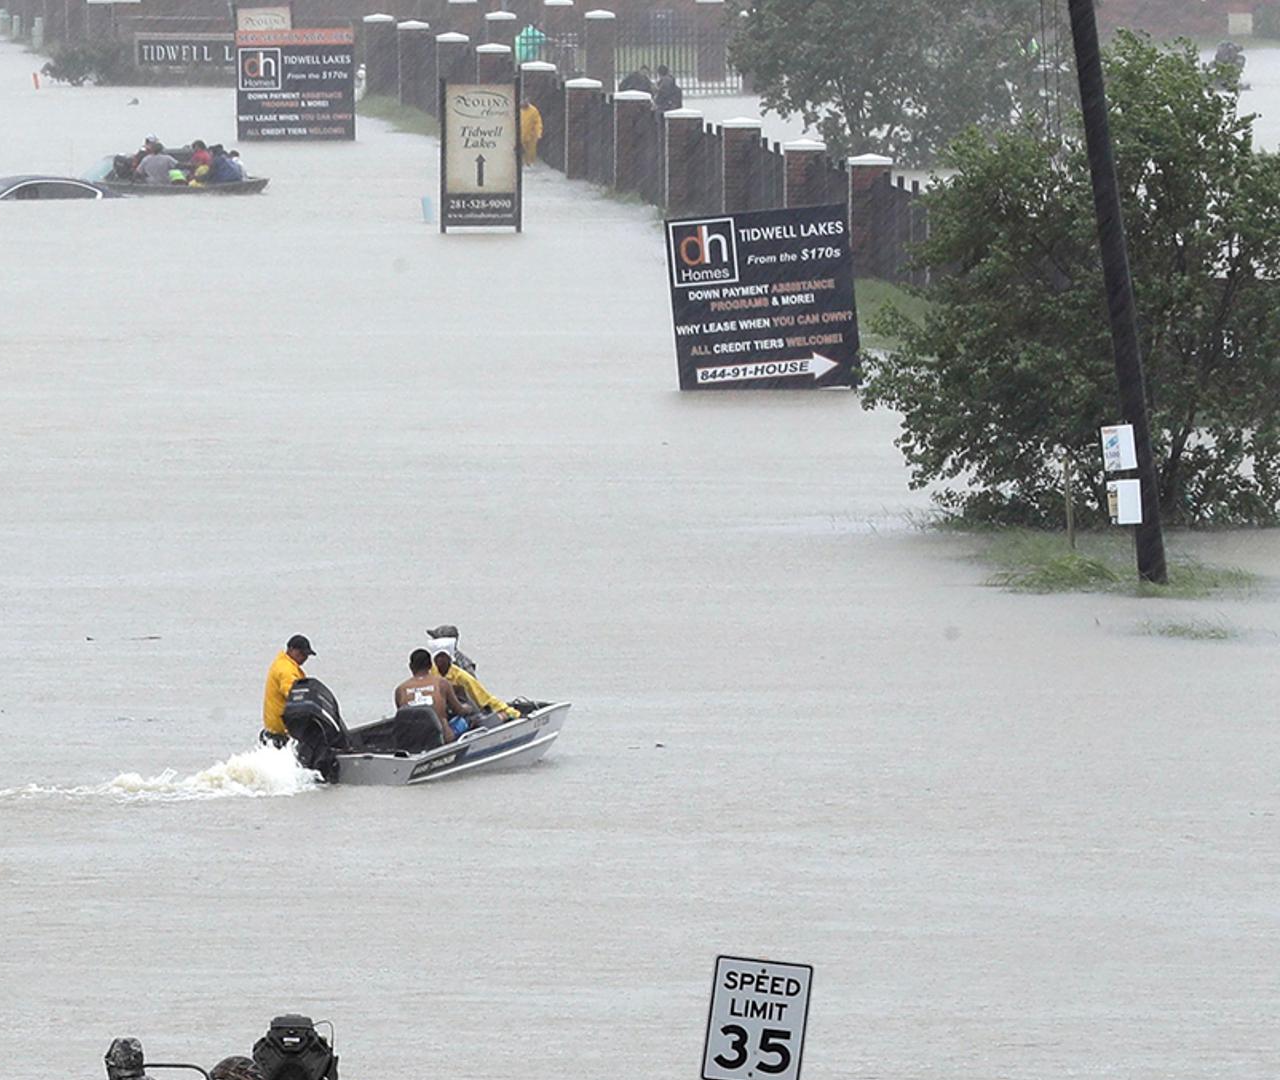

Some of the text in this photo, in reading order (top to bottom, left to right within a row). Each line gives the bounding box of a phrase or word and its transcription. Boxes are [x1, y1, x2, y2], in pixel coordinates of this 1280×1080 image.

[283, 55, 352, 65] TIDWELL LAKES
[460, 126, 504, 137] Tidwell
[463, 138, 497, 149] Lakes
[739, 221, 844, 243] TIDWELL LAKES
[679, 224, 729, 266] dh
[747, 247, 842, 266] From the $170s
[681, 268, 731, 282] Homes
[688, 279, 836, 301] DOWN PAYMENT ASSISTANCE
[710, 293, 815, 312] PROGRAMS & MORE!
[676, 310, 853, 336] WHY LEASE WHEN YOU CAN OWN?
[690, 333, 844, 356] ALL CREDIT TIERS WELCOME!
[700, 361, 810, 381] 844-91-HOUSE
[724, 971, 801, 997] SPEED
[729, 998, 788, 1021] LIMIT
[713, 1024, 792, 1074] 35
